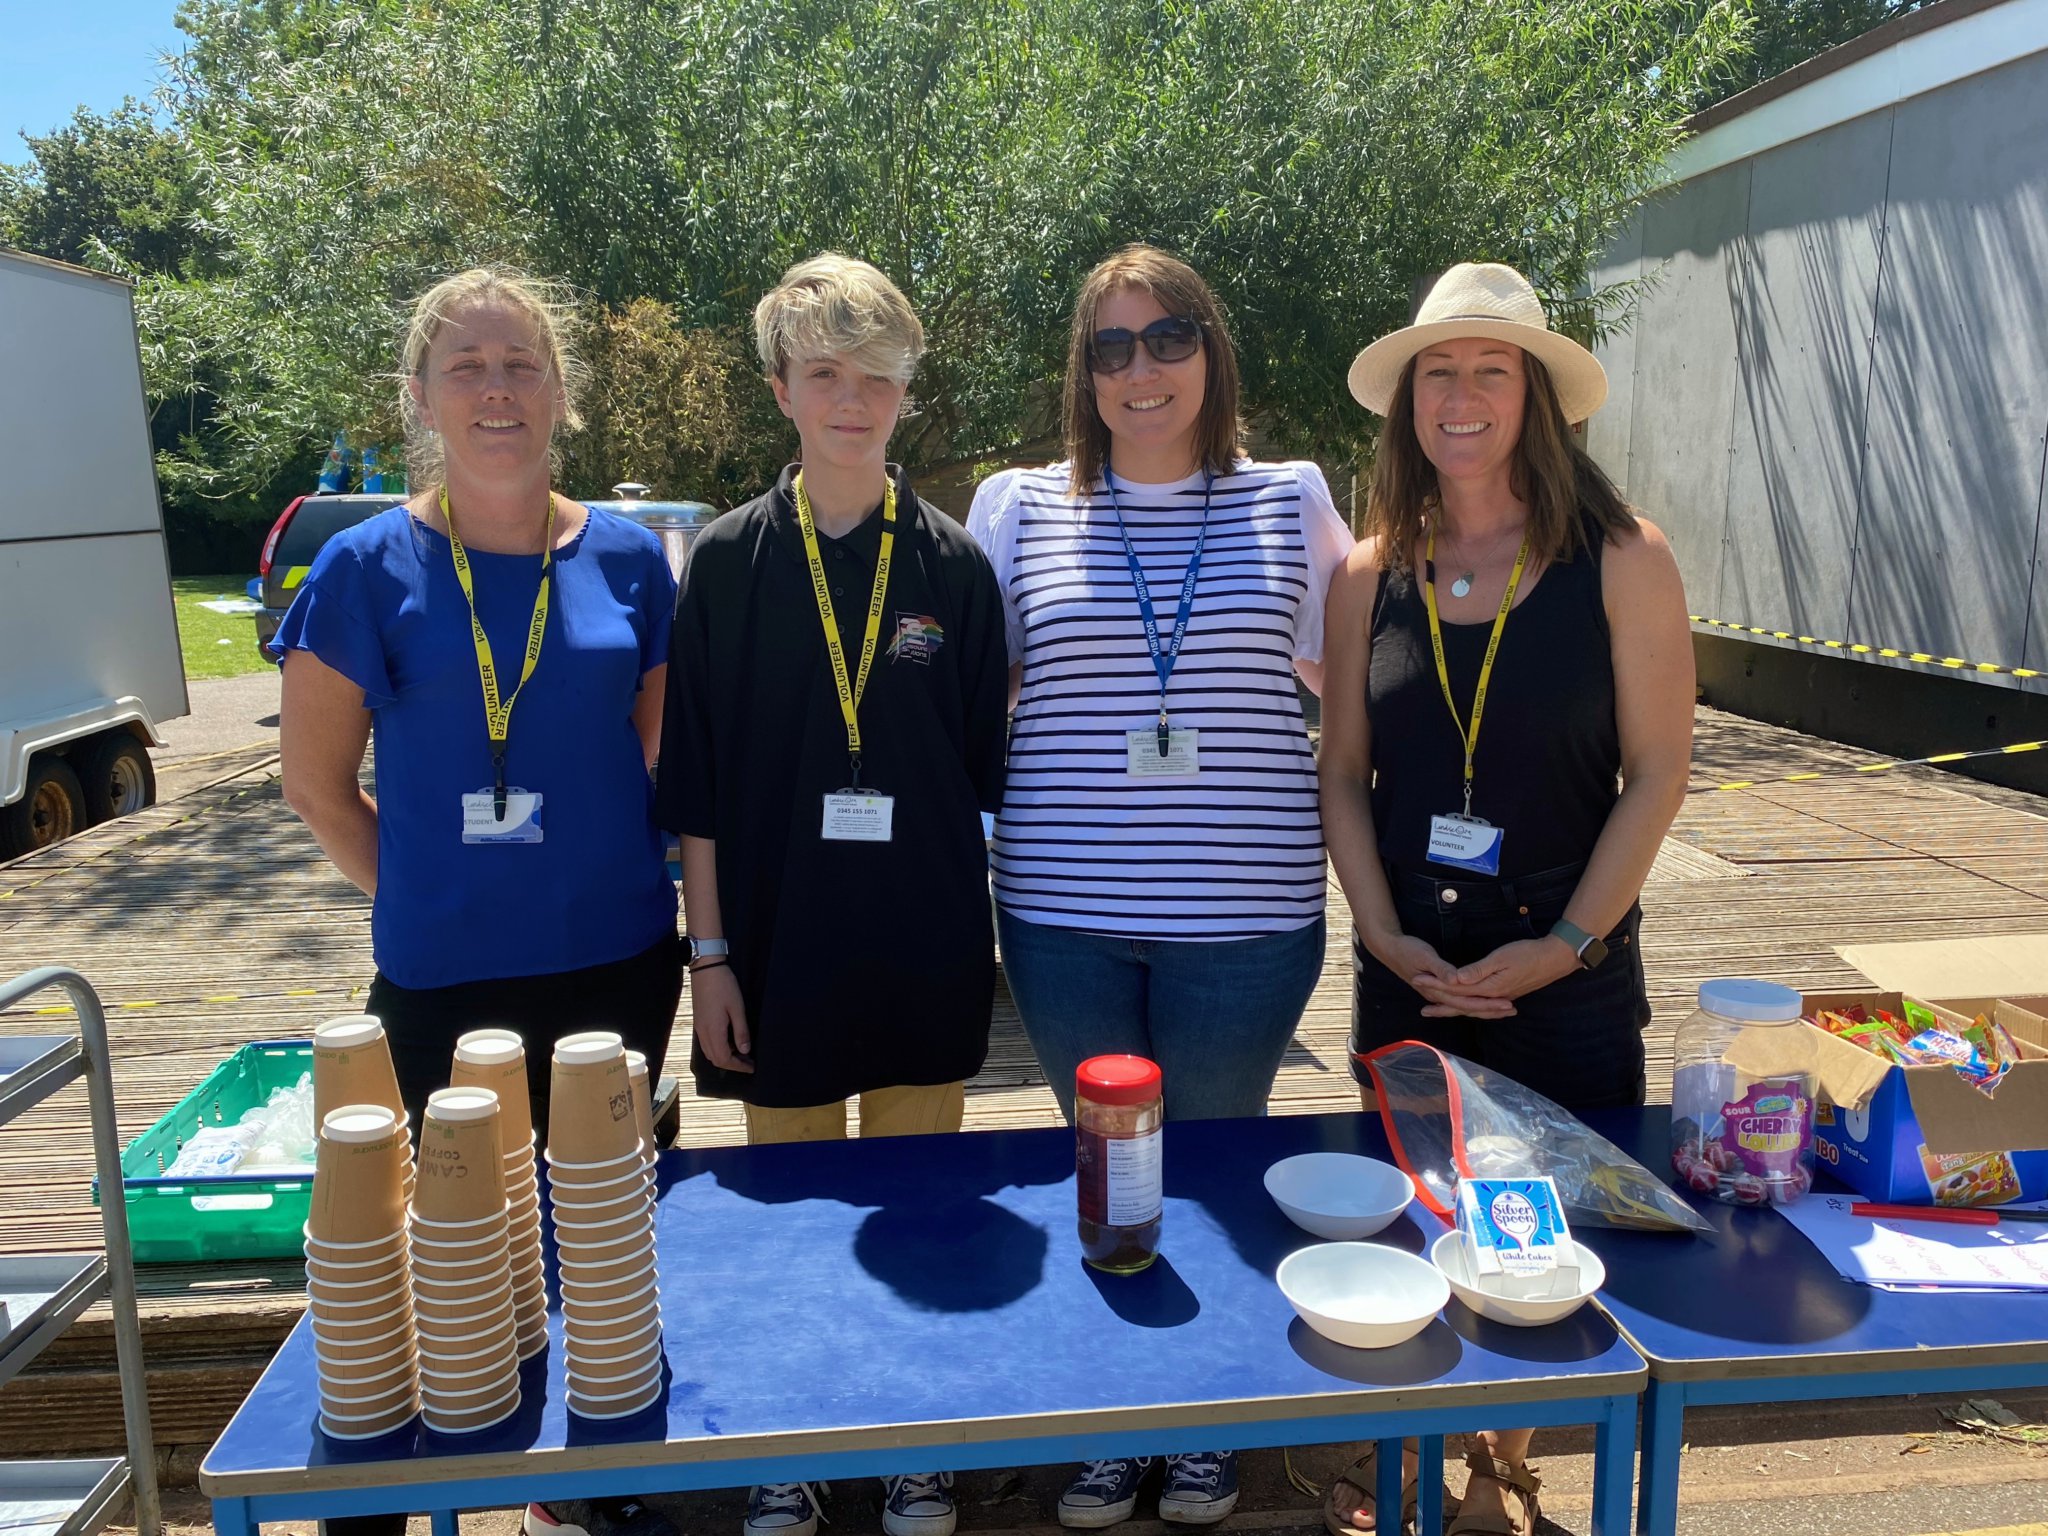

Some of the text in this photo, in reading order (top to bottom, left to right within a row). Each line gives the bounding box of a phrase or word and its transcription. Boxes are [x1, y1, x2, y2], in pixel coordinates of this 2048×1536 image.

[811, 557, 832, 620] VOLUNTEER
[871, 557, 889, 617] VOLUNTEER
[1134, 570, 1149, 604] VISITOR
[1182, 571, 1196, 605] VISITOR
[1500, 584, 1515, 614] VOLUNTEER
[527, 606, 546, 661] VOLUNTEER
[1145, 620, 1160, 658] VISITOR
[1169, 621, 1186, 658] VISITOR
[1485, 635, 1498, 667] VOLUNTEER
[829, 640, 851, 703] VOLUNTEER
[855, 638, 875, 699] VOLUNTEER
[1431, 839, 1465, 851] VOLUNTEER
[1725, 1107, 1751, 1116] SOUR
[1740, 1117, 1801, 1135] CHERRY
[1738, 1132, 1801, 1153] LOLLIES
[1842, 1142, 1859, 1158] Treat
[1493, 1204, 1532, 1216] Silver
[1502, 1252, 1553, 1261] White Cubes
